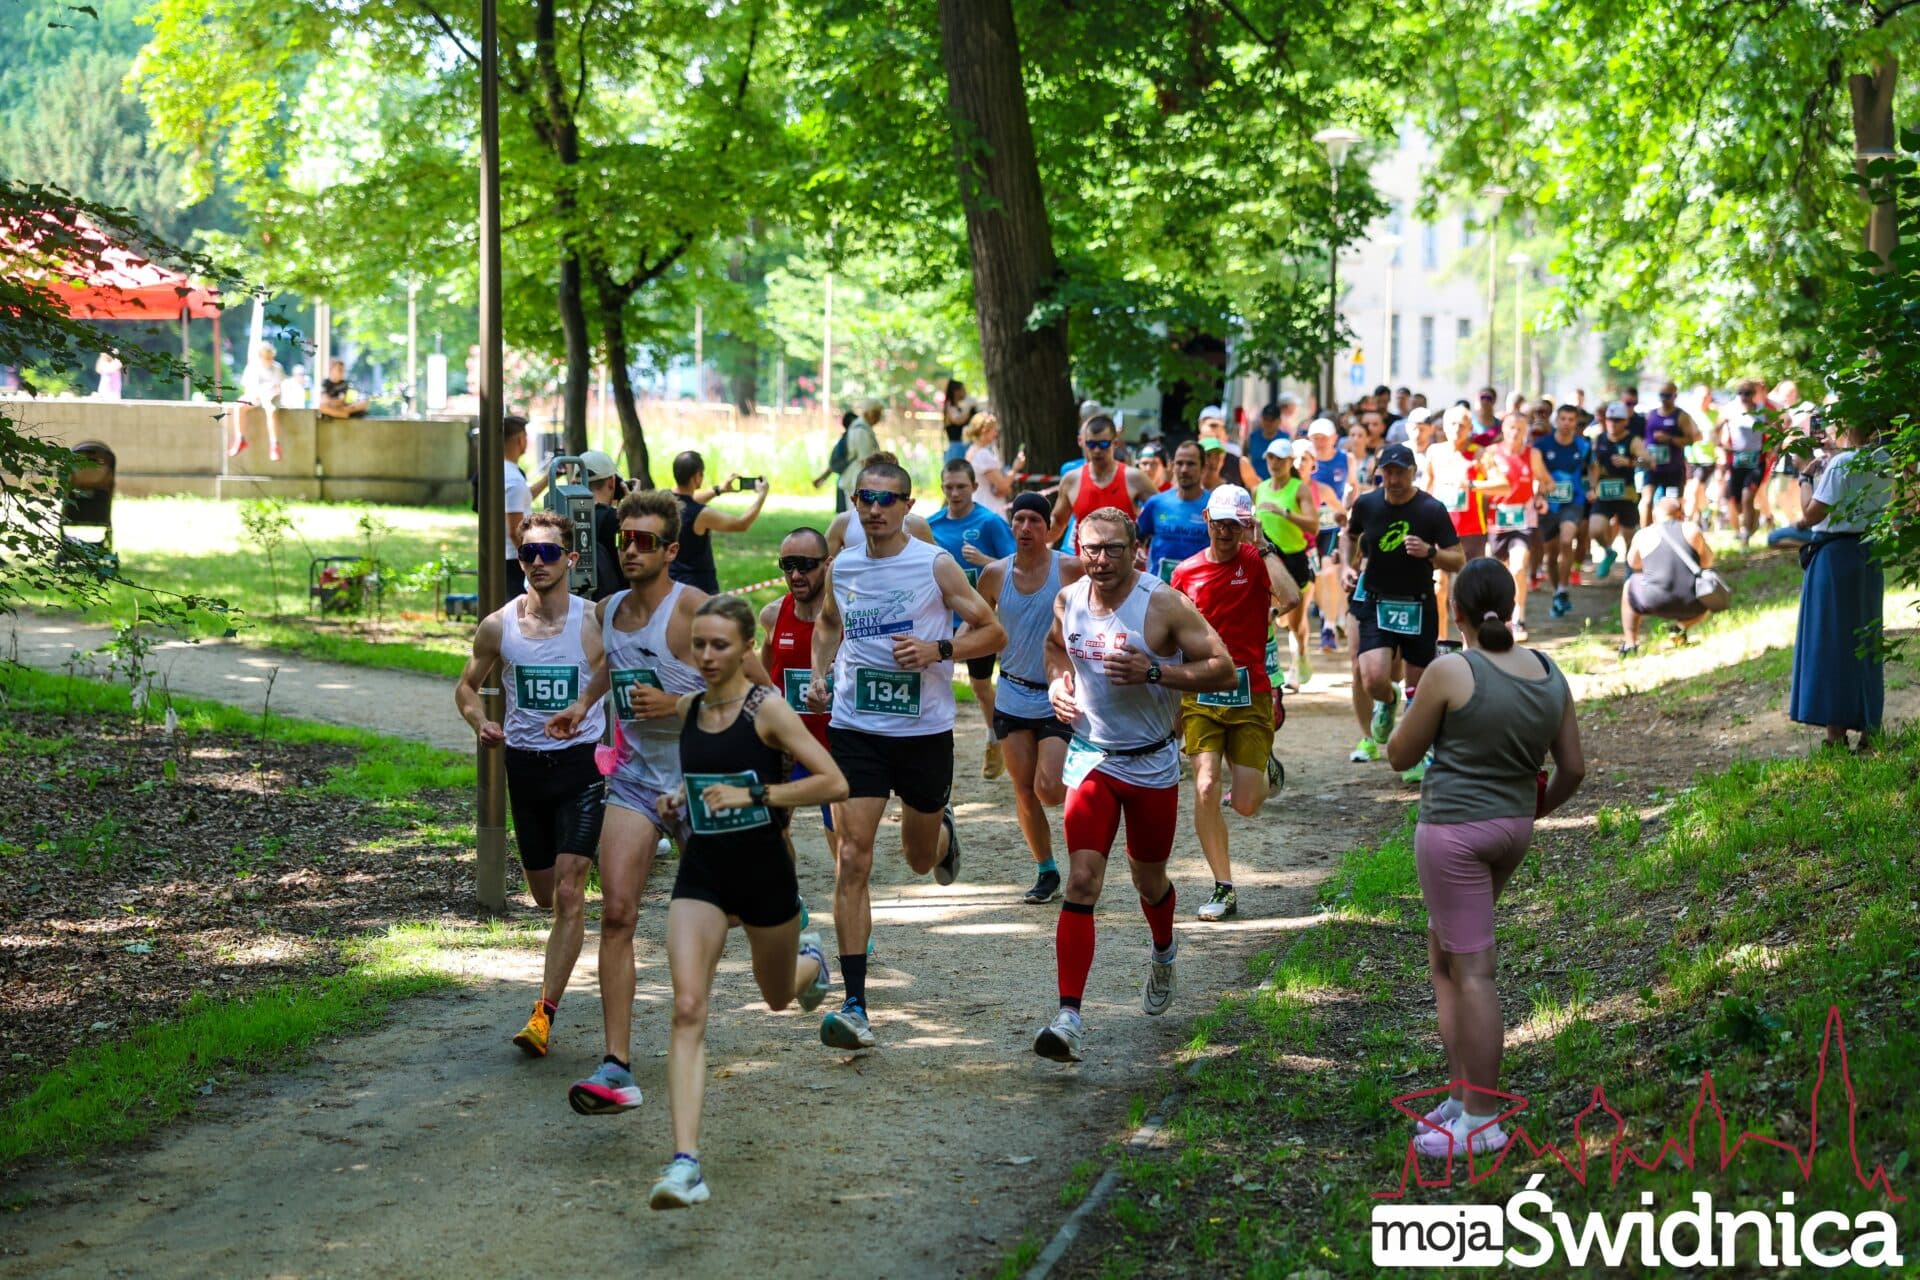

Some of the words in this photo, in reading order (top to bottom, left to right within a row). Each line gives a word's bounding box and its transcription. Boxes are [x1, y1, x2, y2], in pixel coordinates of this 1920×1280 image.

[852, 608, 879, 618] GRAND
[1388, 610, 1409, 625] 78
[853, 616, 878, 629] PRIX
[1069, 648, 1119, 660] POLS
[524, 679, 569, 700] 150
[866, 681, 911, 704] 134
